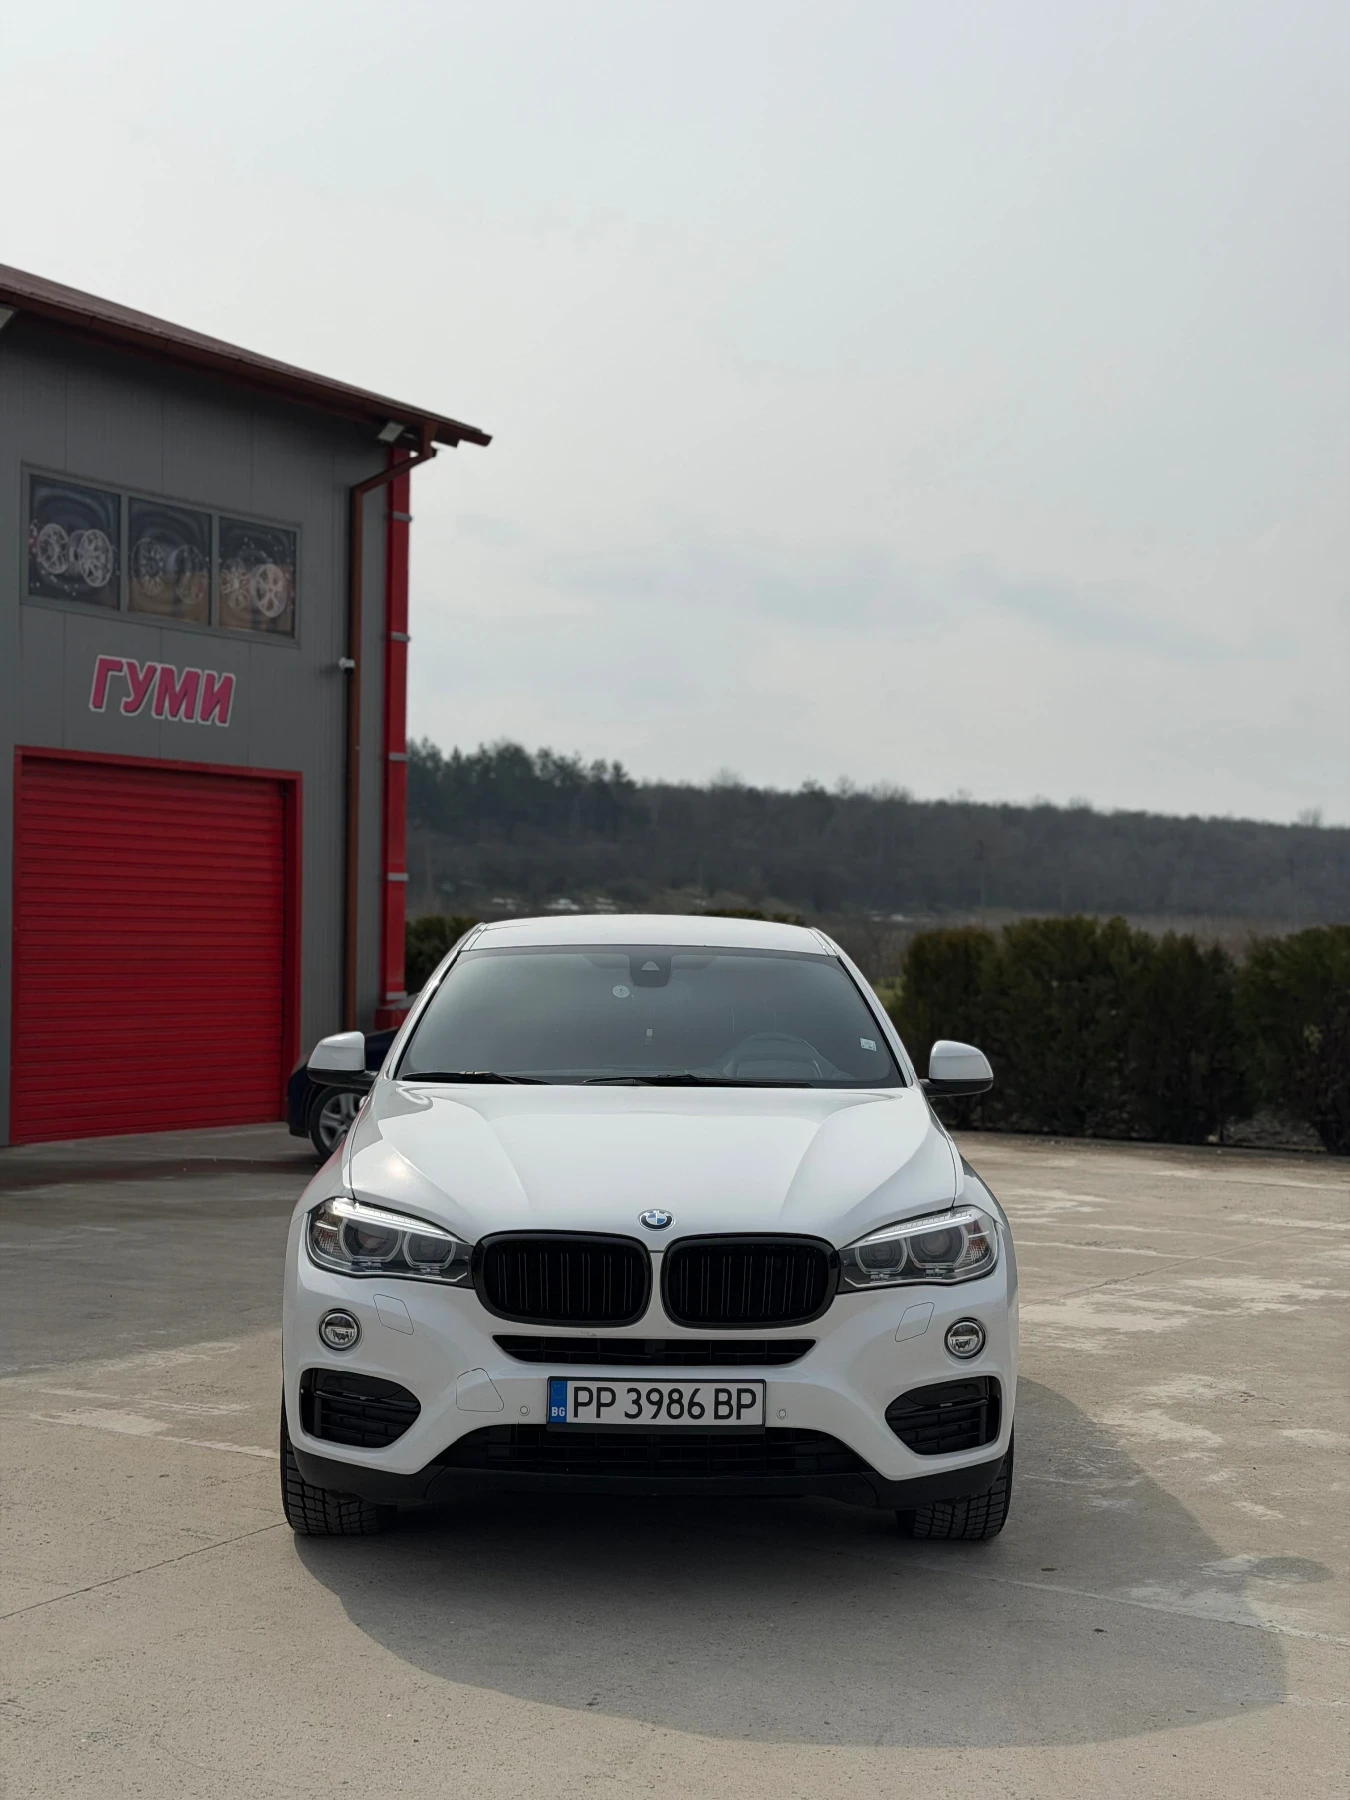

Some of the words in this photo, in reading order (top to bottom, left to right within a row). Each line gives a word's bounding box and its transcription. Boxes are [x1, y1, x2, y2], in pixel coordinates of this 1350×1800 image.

[89, 655, 236, 726] ГУМИ
[551, 1406, 566, 1417] BG
[573, 1386, 616, 1418] PP
[624, 1387, 705, 1420] 3986
[714, 1388, 757, 1420] BP
